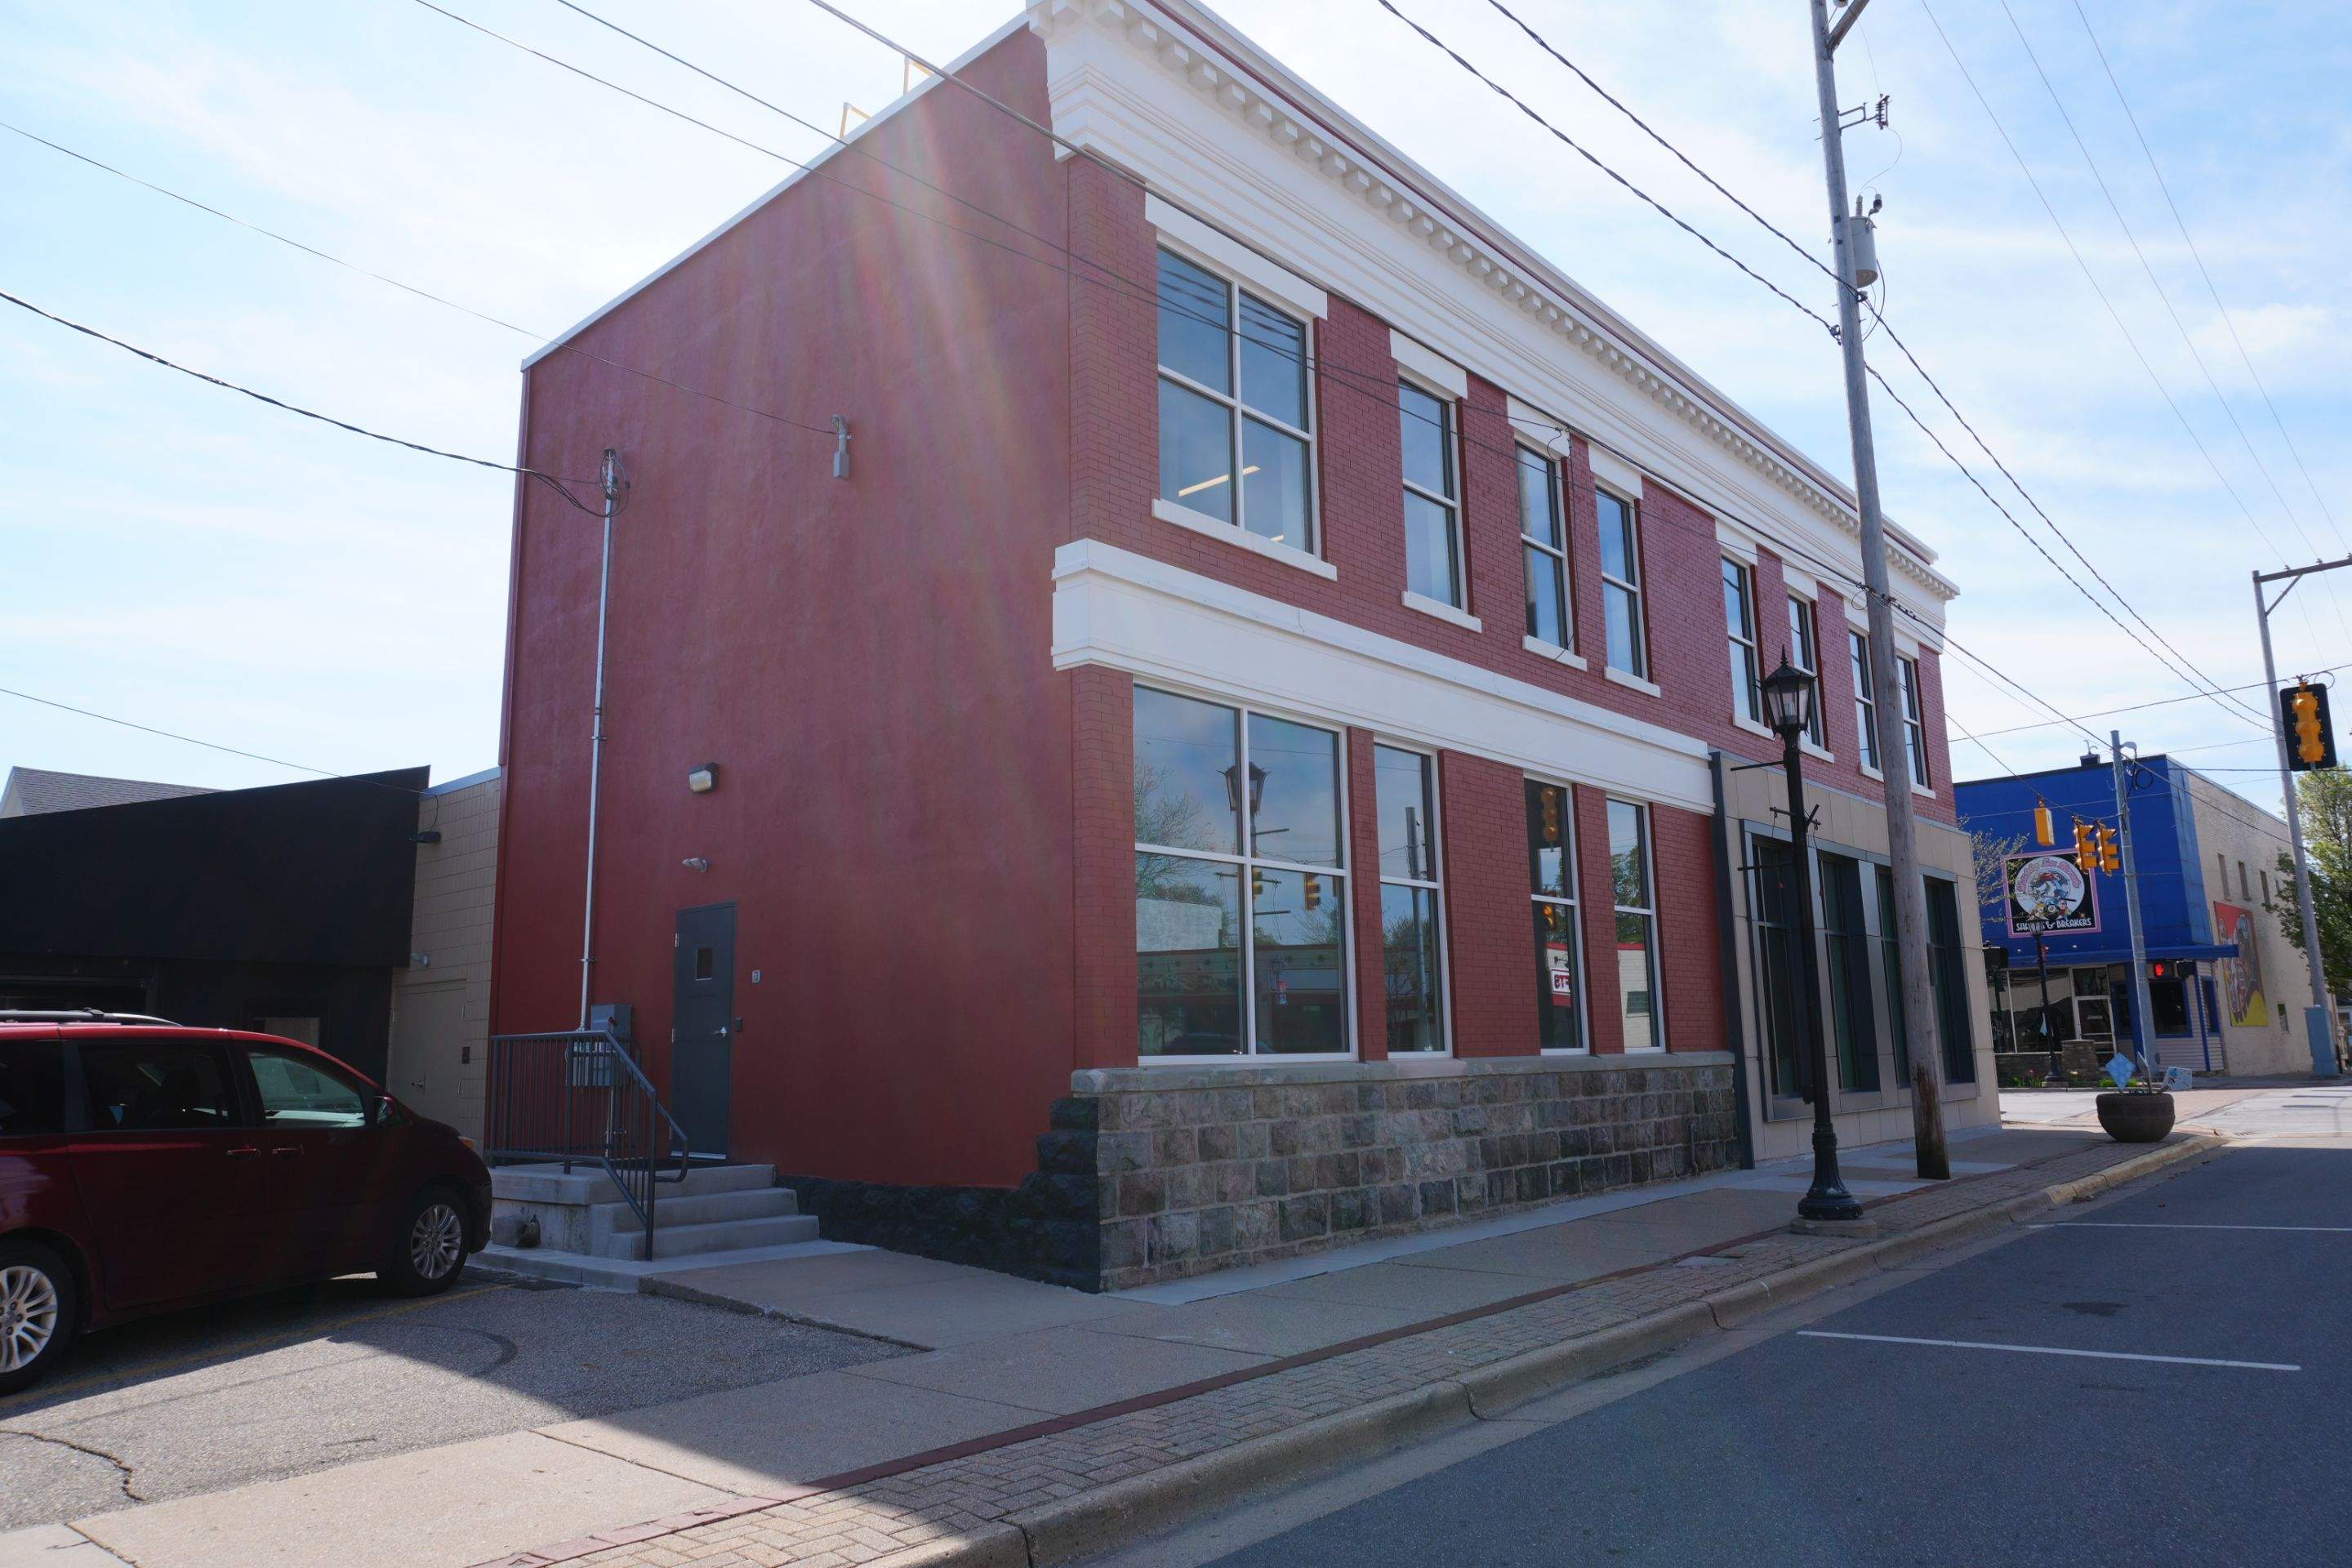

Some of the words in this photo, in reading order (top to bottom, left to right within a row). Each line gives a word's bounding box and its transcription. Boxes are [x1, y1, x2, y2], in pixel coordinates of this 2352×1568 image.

[2016, 921, 2045, 932] SHAS
[2046, 921, 2056, 929] &
[2056, 918, 2091, 929] BREAKERS
